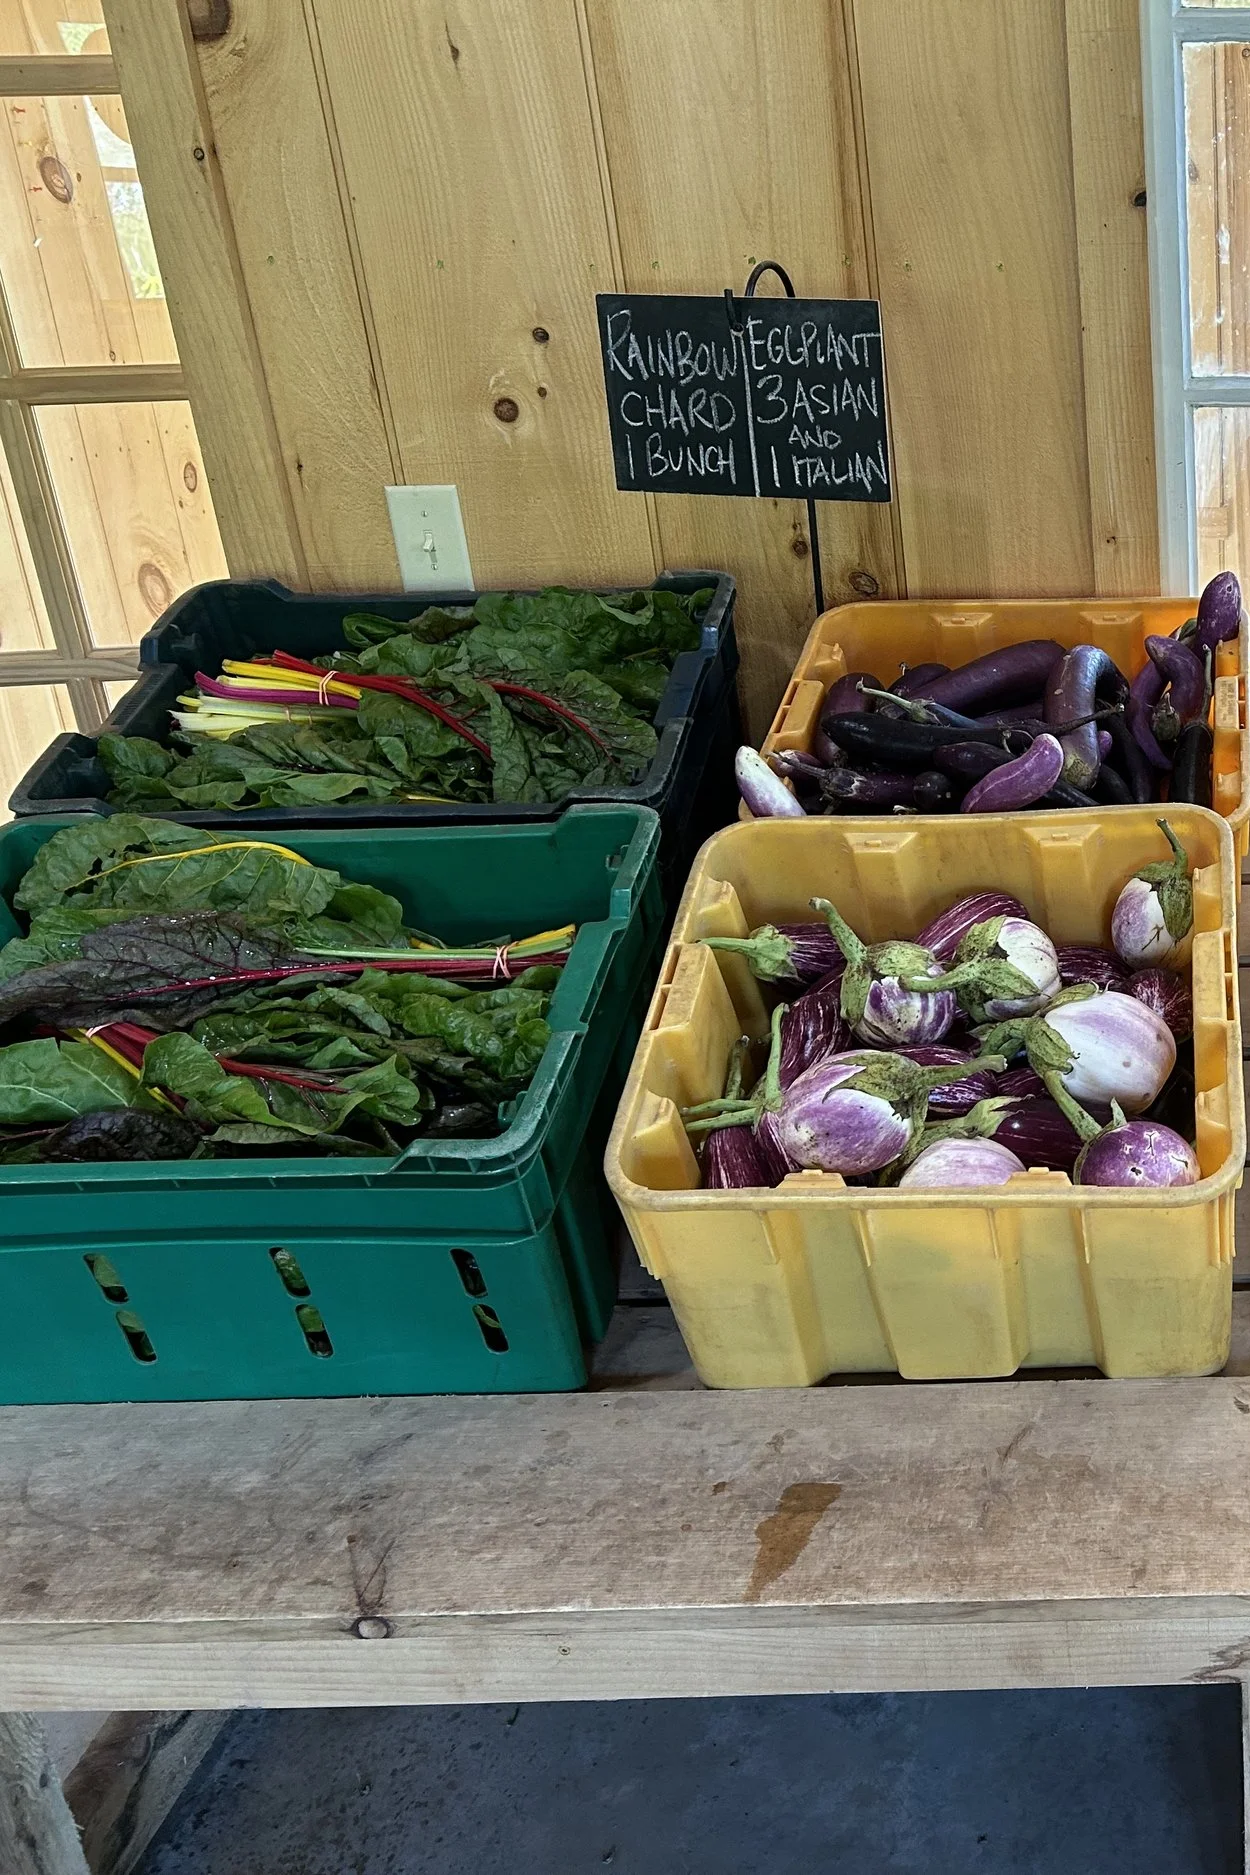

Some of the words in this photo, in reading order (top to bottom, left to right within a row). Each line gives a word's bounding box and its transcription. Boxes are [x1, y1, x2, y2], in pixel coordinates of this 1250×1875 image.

[606, 309, 738, 385] RAINBOW
[746, 316, 882, 371] EGGPLANT
[620, 384, 737, 436] CHARD
[756, 374, 789, 424] 3
[792, 377, 879, 424] ASIAN
[625, 433, 635, 480] 1
[645, 431, 737, 485] BUNCH
[788, 424, 842, 450] AND
[769, 445, 781, 489] 1
[792, 439, 888, 494] ITALIAN
